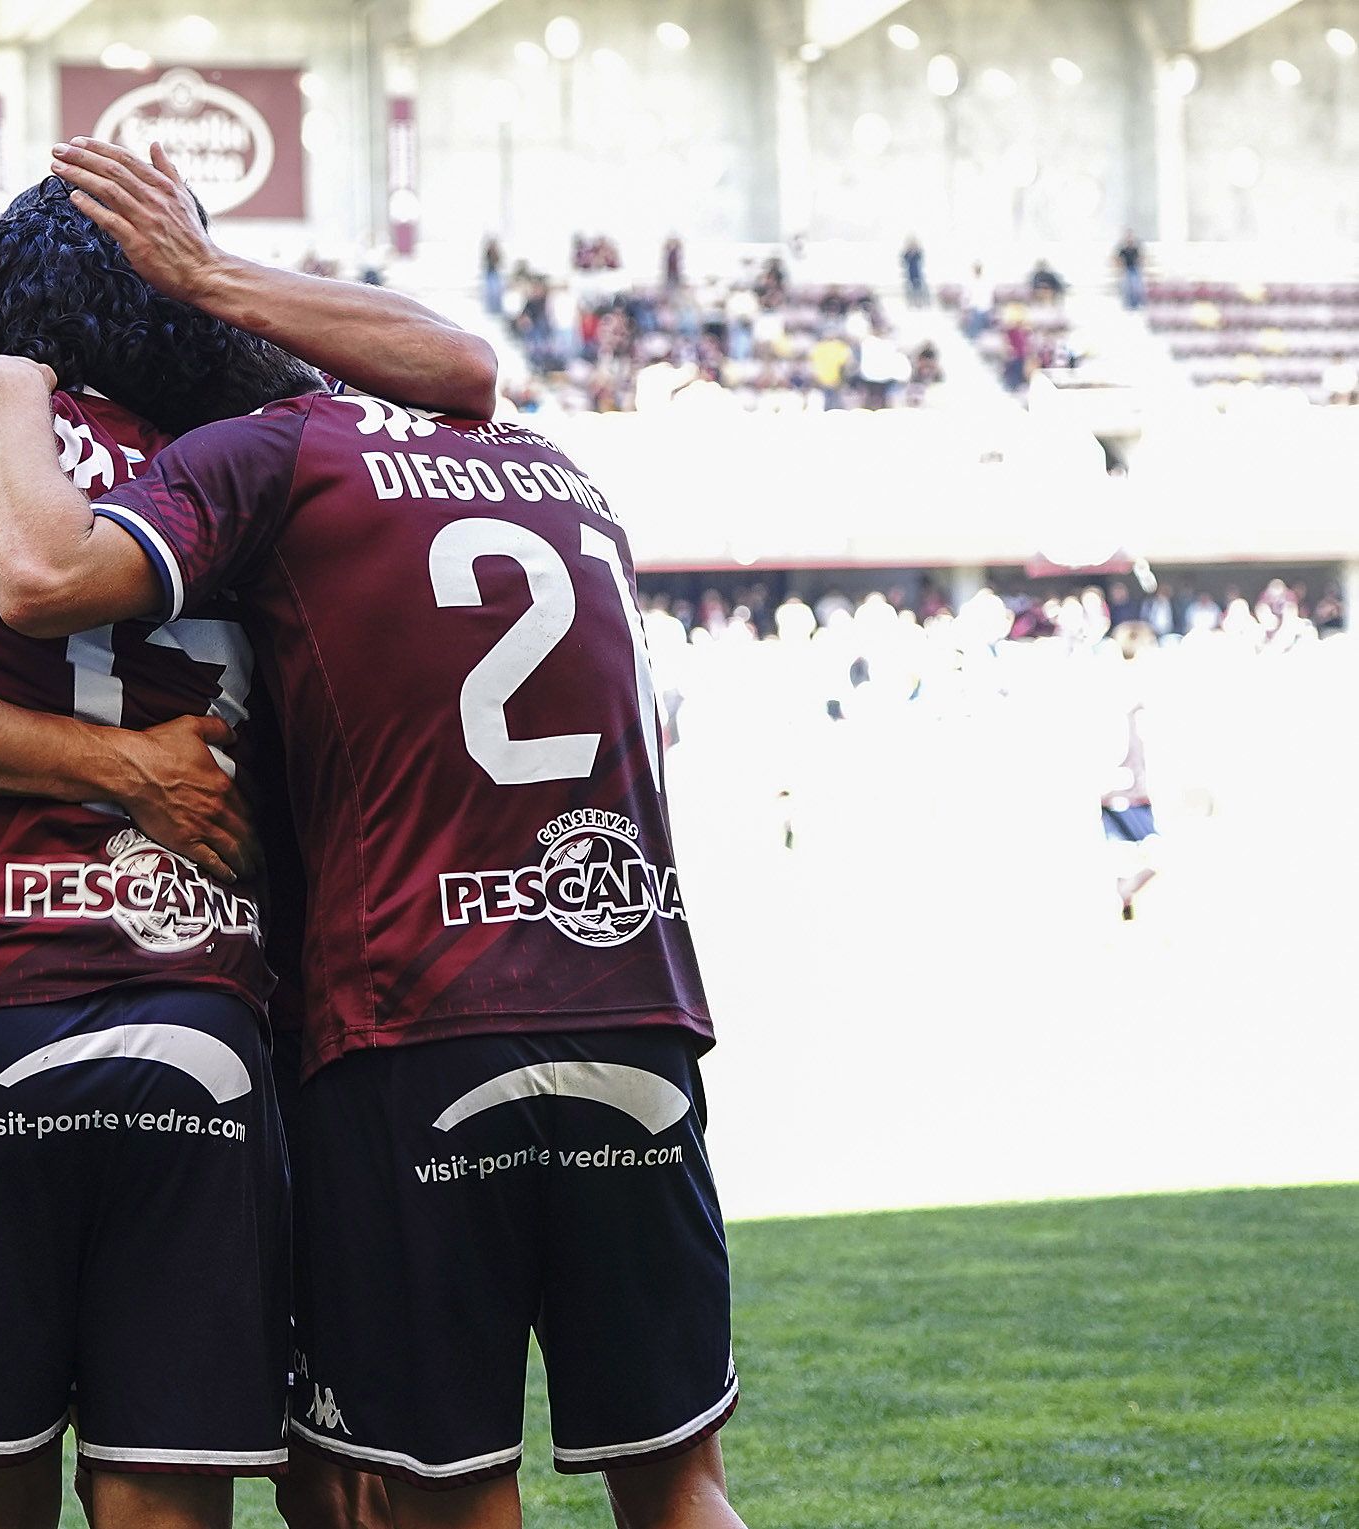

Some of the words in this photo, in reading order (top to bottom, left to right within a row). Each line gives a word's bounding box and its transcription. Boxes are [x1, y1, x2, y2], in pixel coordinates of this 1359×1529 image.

[361, 451, 506, 502] DIEGO
[502, 461, 615, 523] GOME
[537, 808, 639, 846] CONSERVAS
